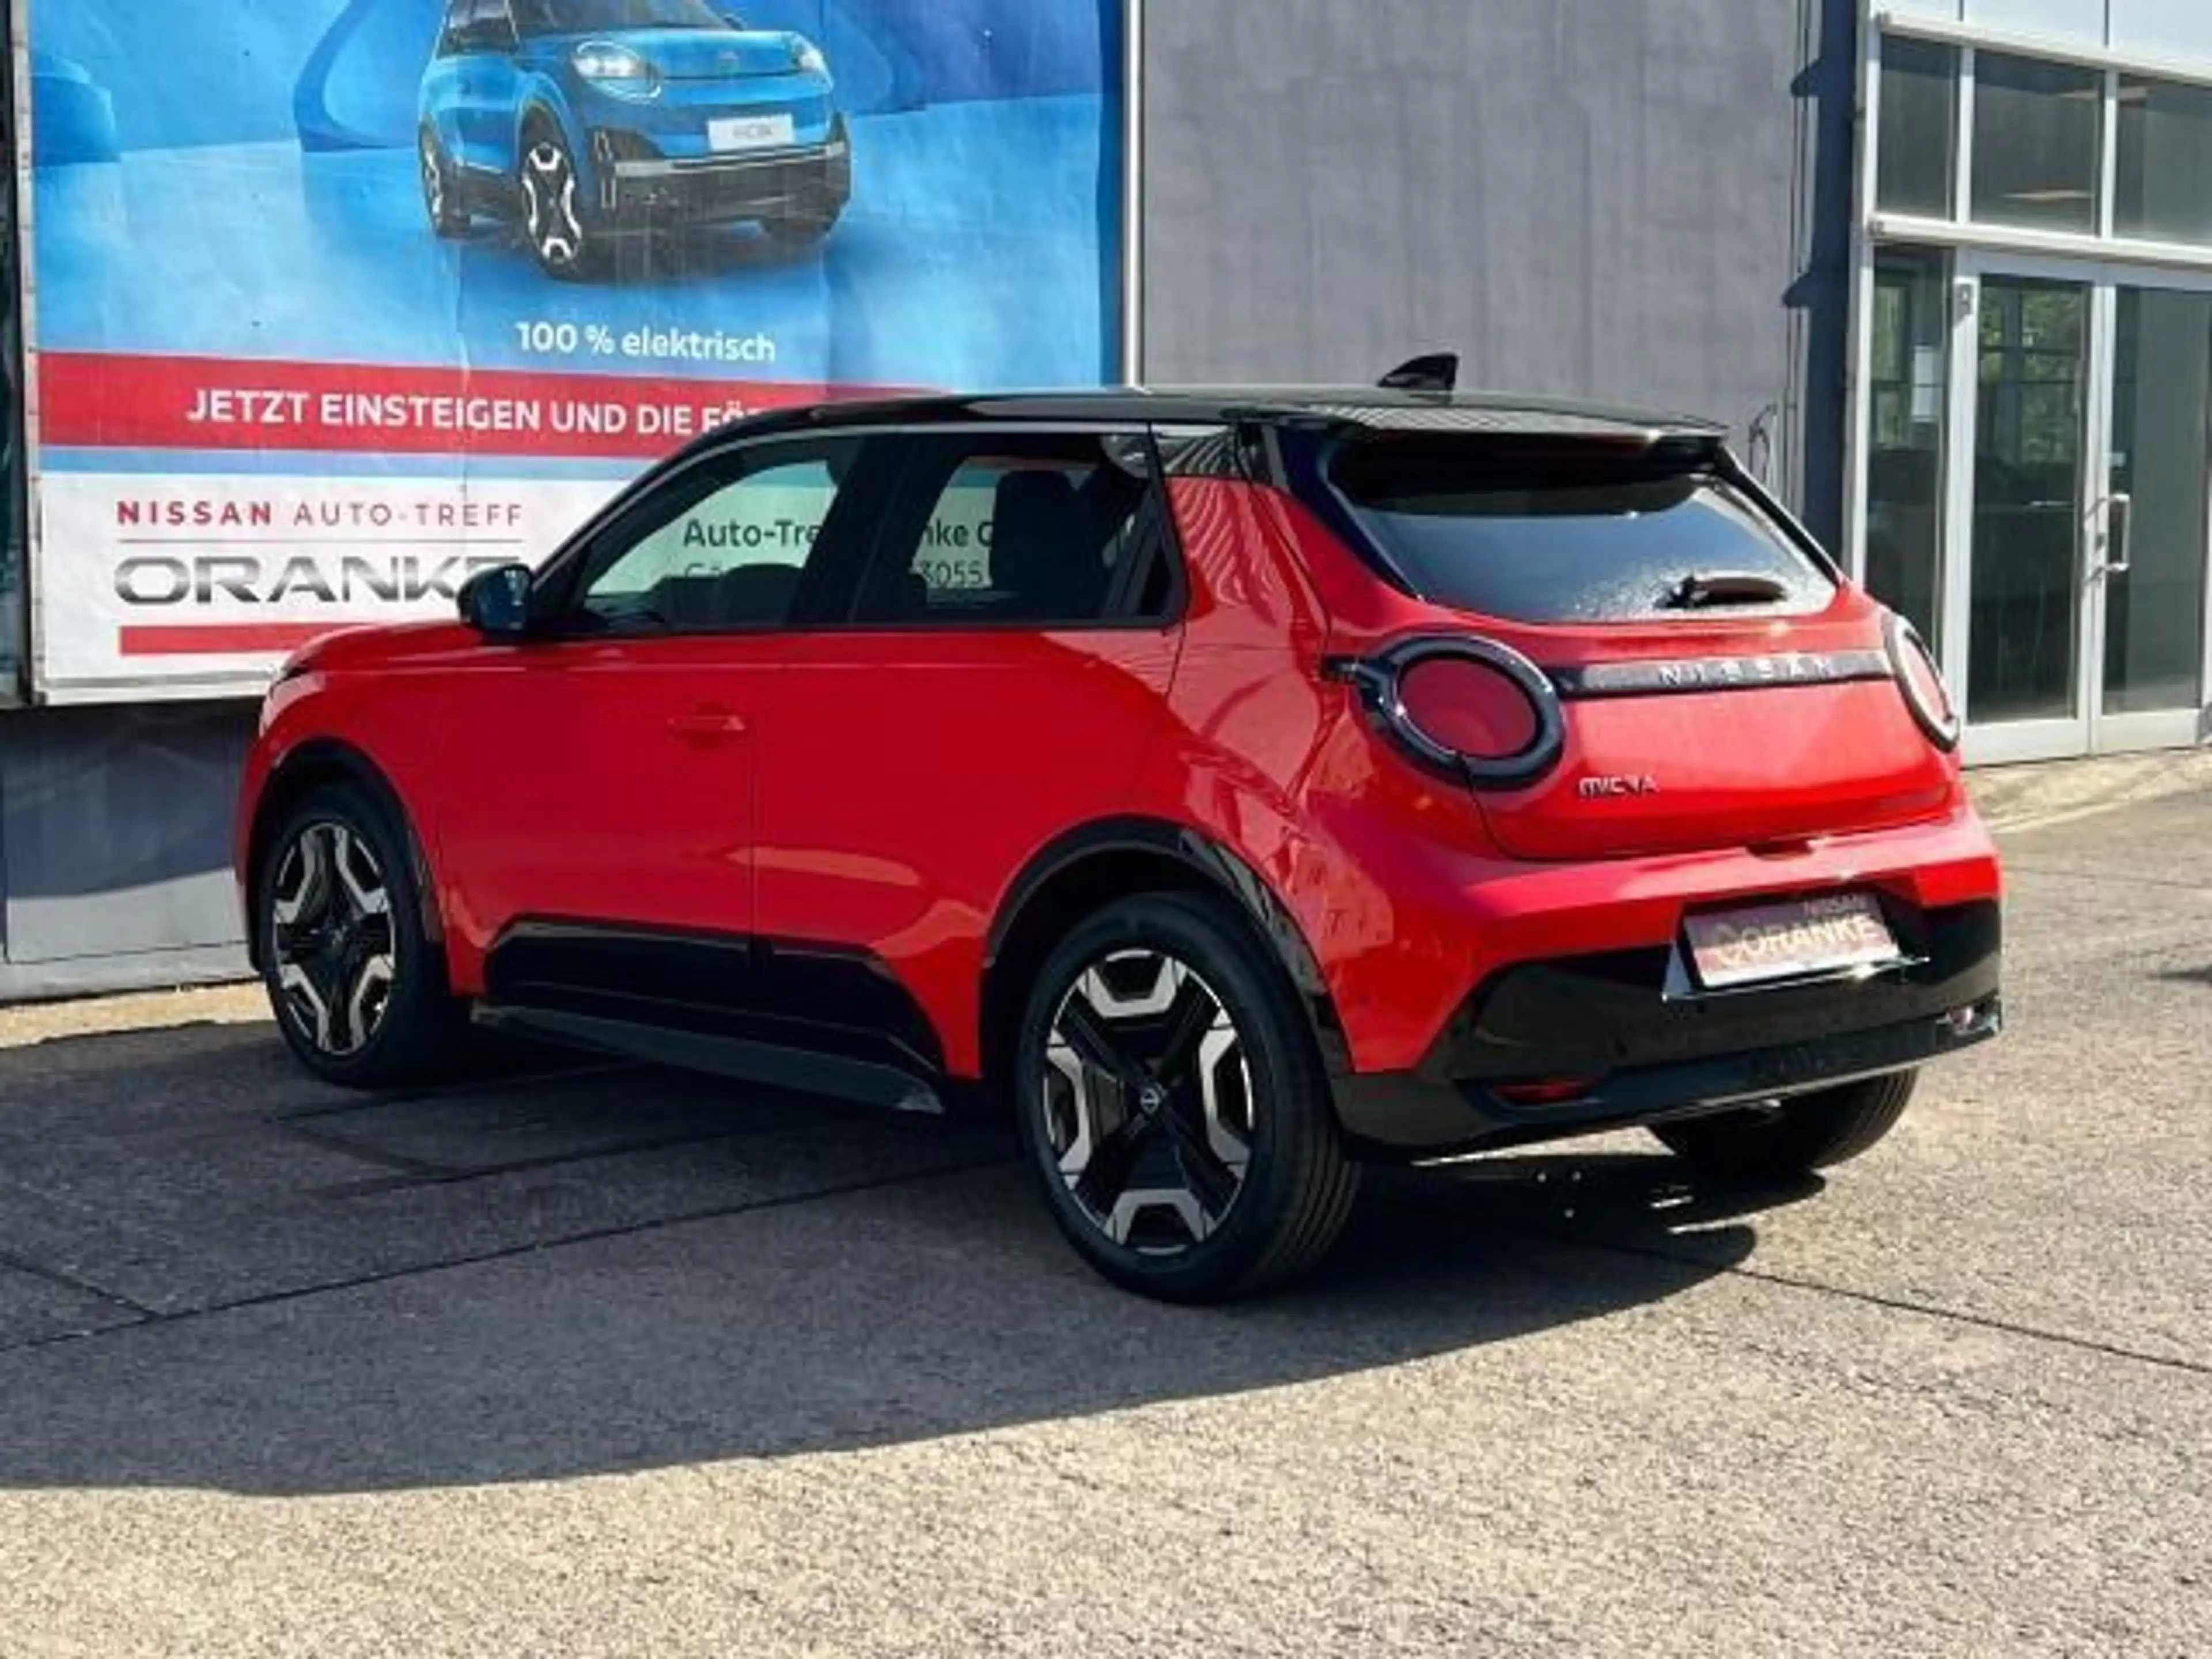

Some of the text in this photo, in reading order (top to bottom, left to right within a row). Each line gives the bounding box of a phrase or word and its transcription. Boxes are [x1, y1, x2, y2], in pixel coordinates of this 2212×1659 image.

[516, 321, 777, 363] 100 % elektrisch
[185, 389, 765, 435] JETZT EINSTEIGEN UND DIE FÖ
[117, 499, 272, 527] NISSAN
[683, 516, 824, 548] Auto-Tre
[114, 555, 520, 605] ORANK
[1659, 652, 1831, 685] NISSAN
